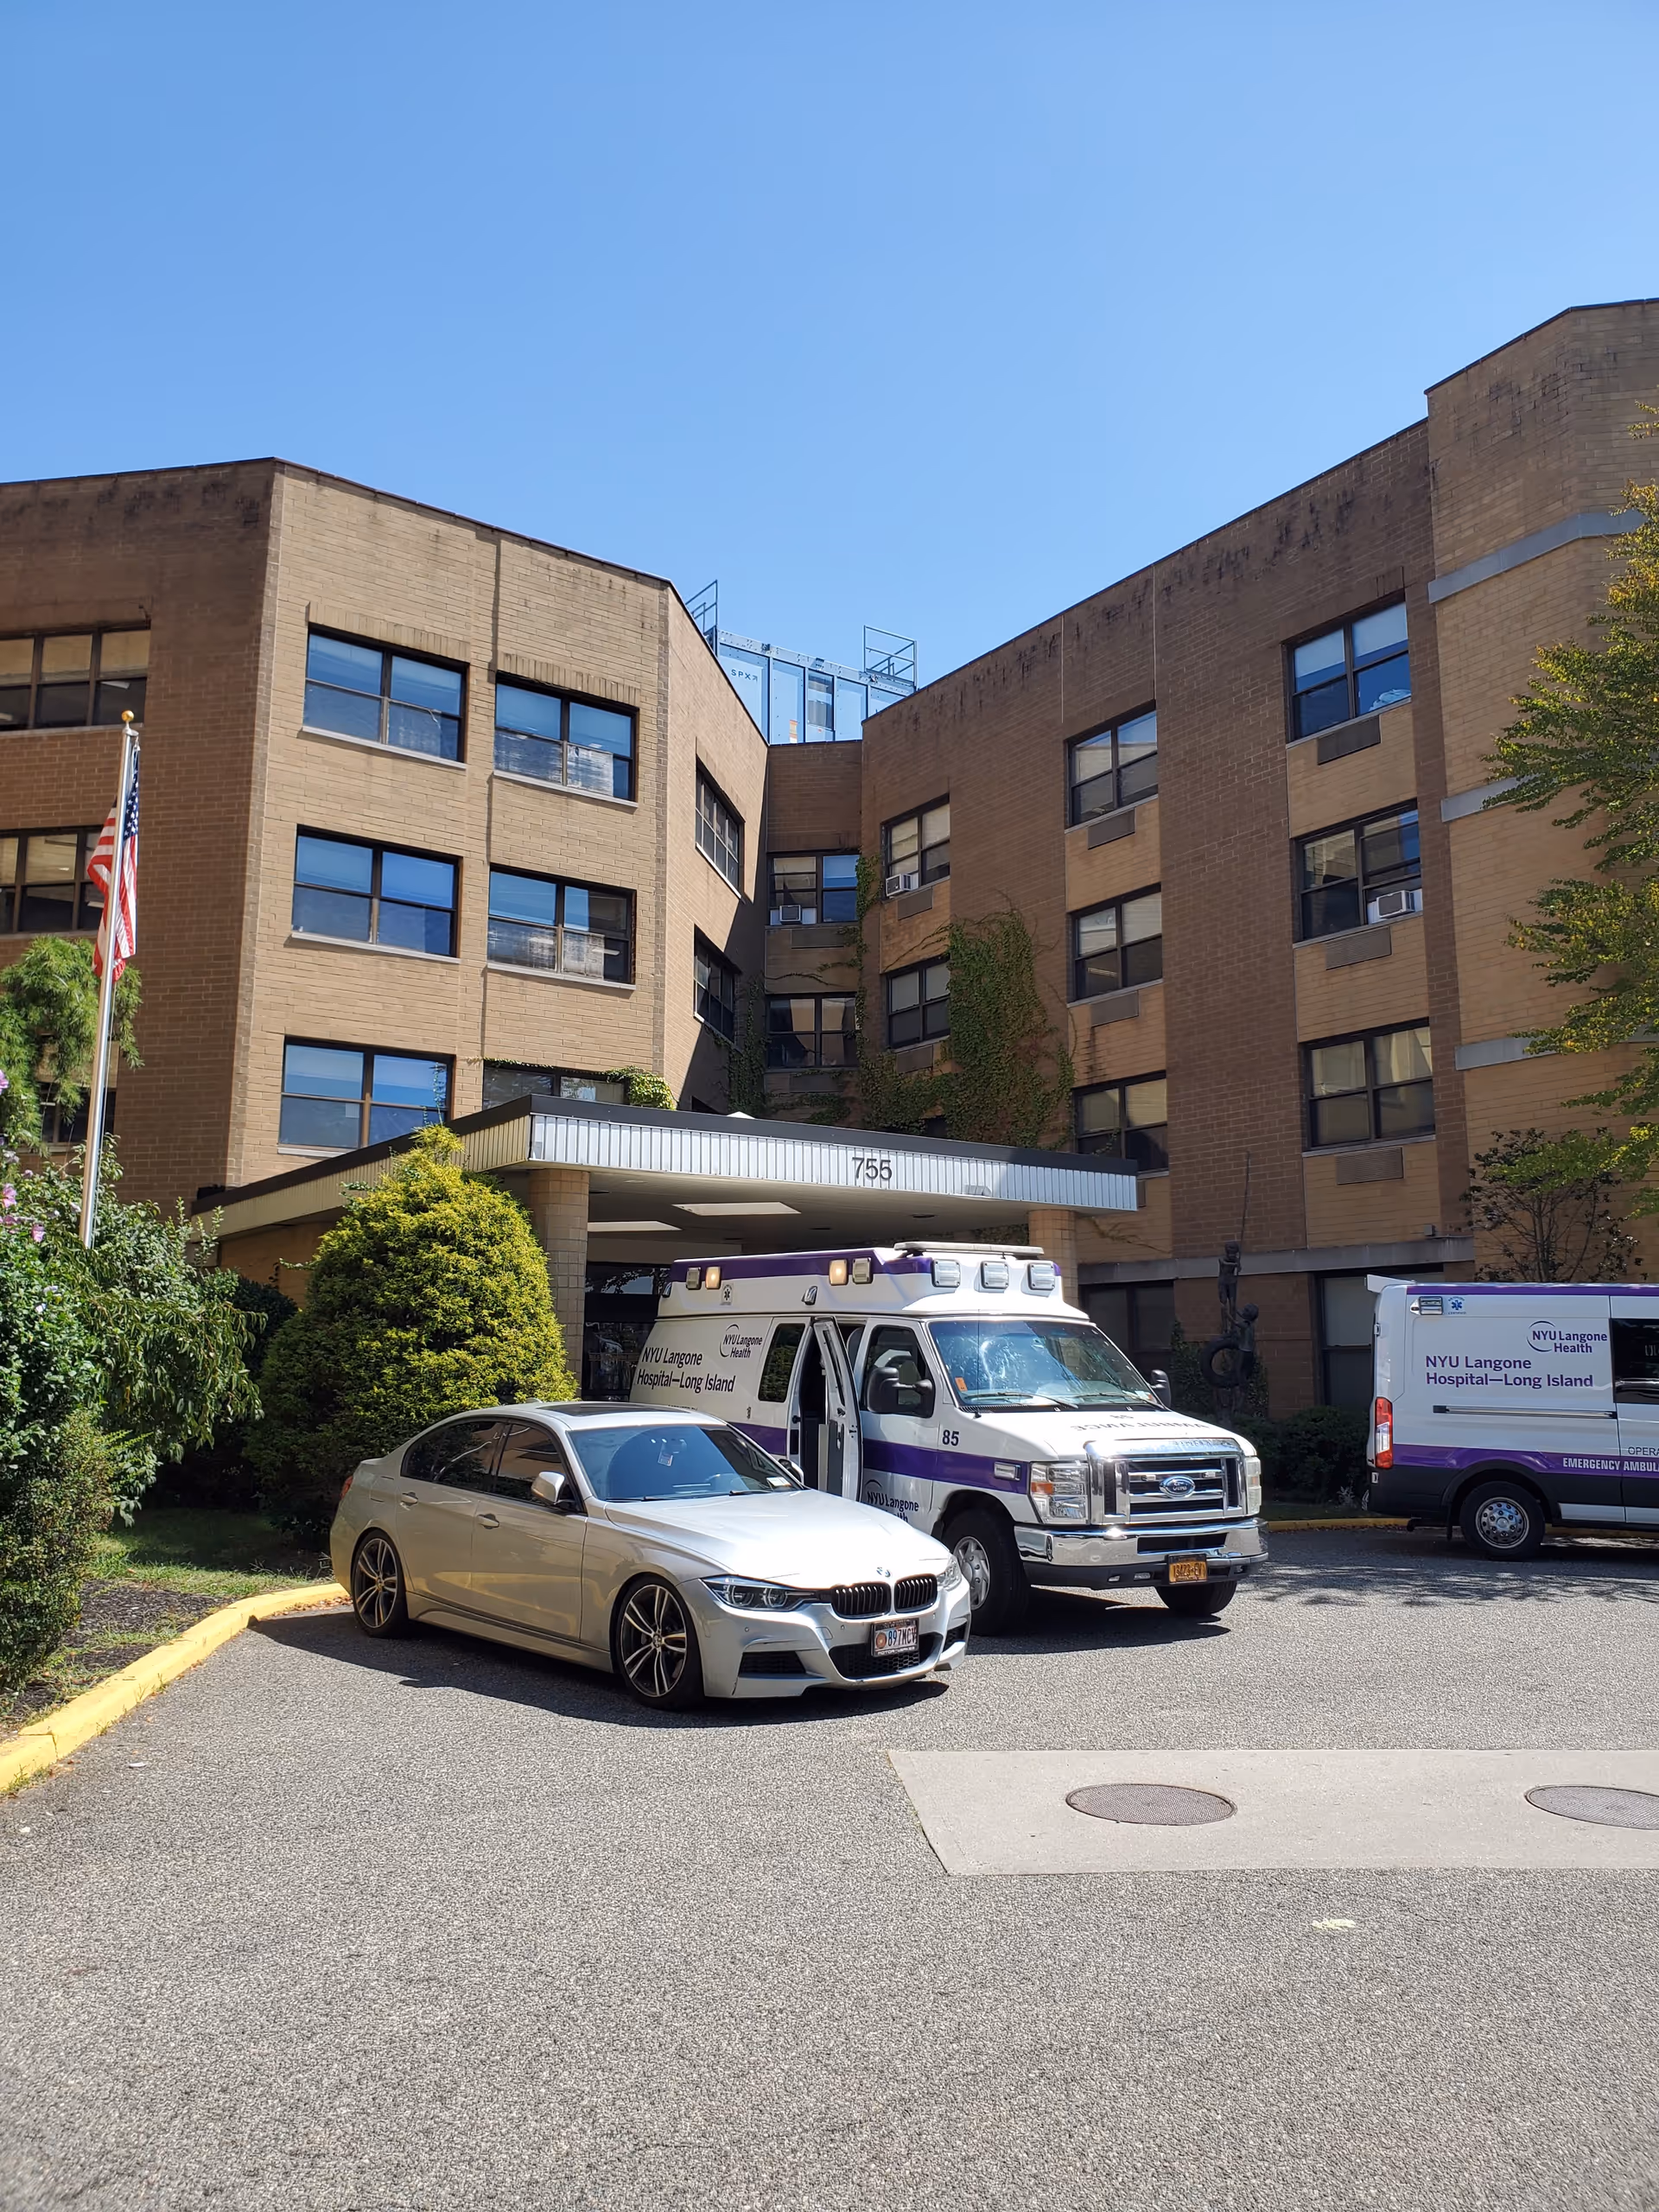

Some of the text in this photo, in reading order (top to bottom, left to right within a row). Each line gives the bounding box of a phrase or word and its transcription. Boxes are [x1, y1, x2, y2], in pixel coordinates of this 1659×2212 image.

[852, 1157, 893, 1180] 755
[723, 1334, 762, 1347] NYU Langone
[1532, 1331, 1608, 1343] NYU Langone
[730, 1347, 751, 1358] Health
[1554, 1343, 1592, 1353] Health
[642, 1347, 702, 1368] NYU Langone
[1426, 1356, 1532, 1371] NYU Langone
[704, 1374, 736, 1392] Island
[1547, 1374, 1593, 1387] Island
[942, 1429, 960, 1446] 85
[1562, 1457, 1659, 1472] EMERGENCY AMBUL
[867, 1491, 919, 1512] NYU Langone
